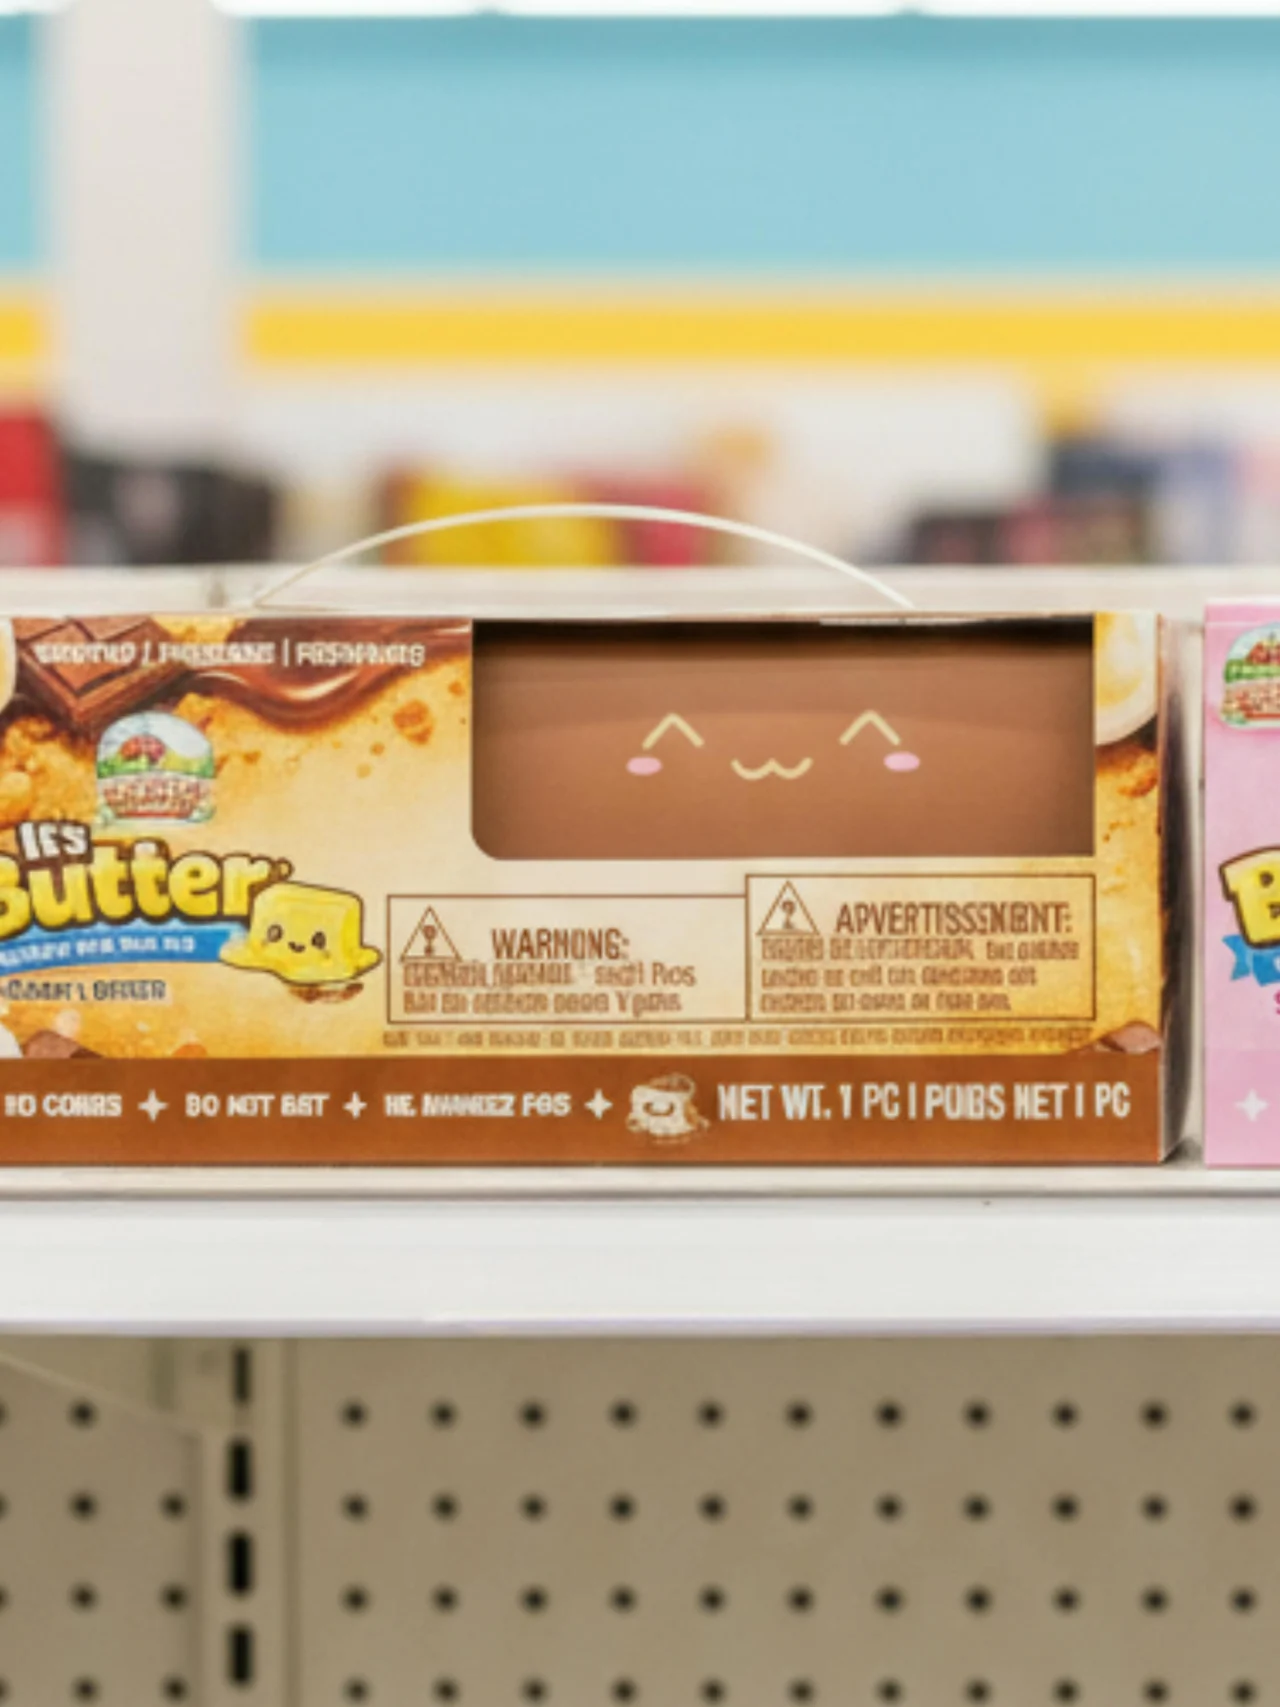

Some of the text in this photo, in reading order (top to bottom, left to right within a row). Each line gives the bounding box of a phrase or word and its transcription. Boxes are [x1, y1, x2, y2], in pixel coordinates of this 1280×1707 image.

[718, 1083, 773, 1121] NET
[780, 1083, 832, 1121] WT.
[863, 1082, 900, 1120] PC
[1094, 1082, 1131, 1118] PC
